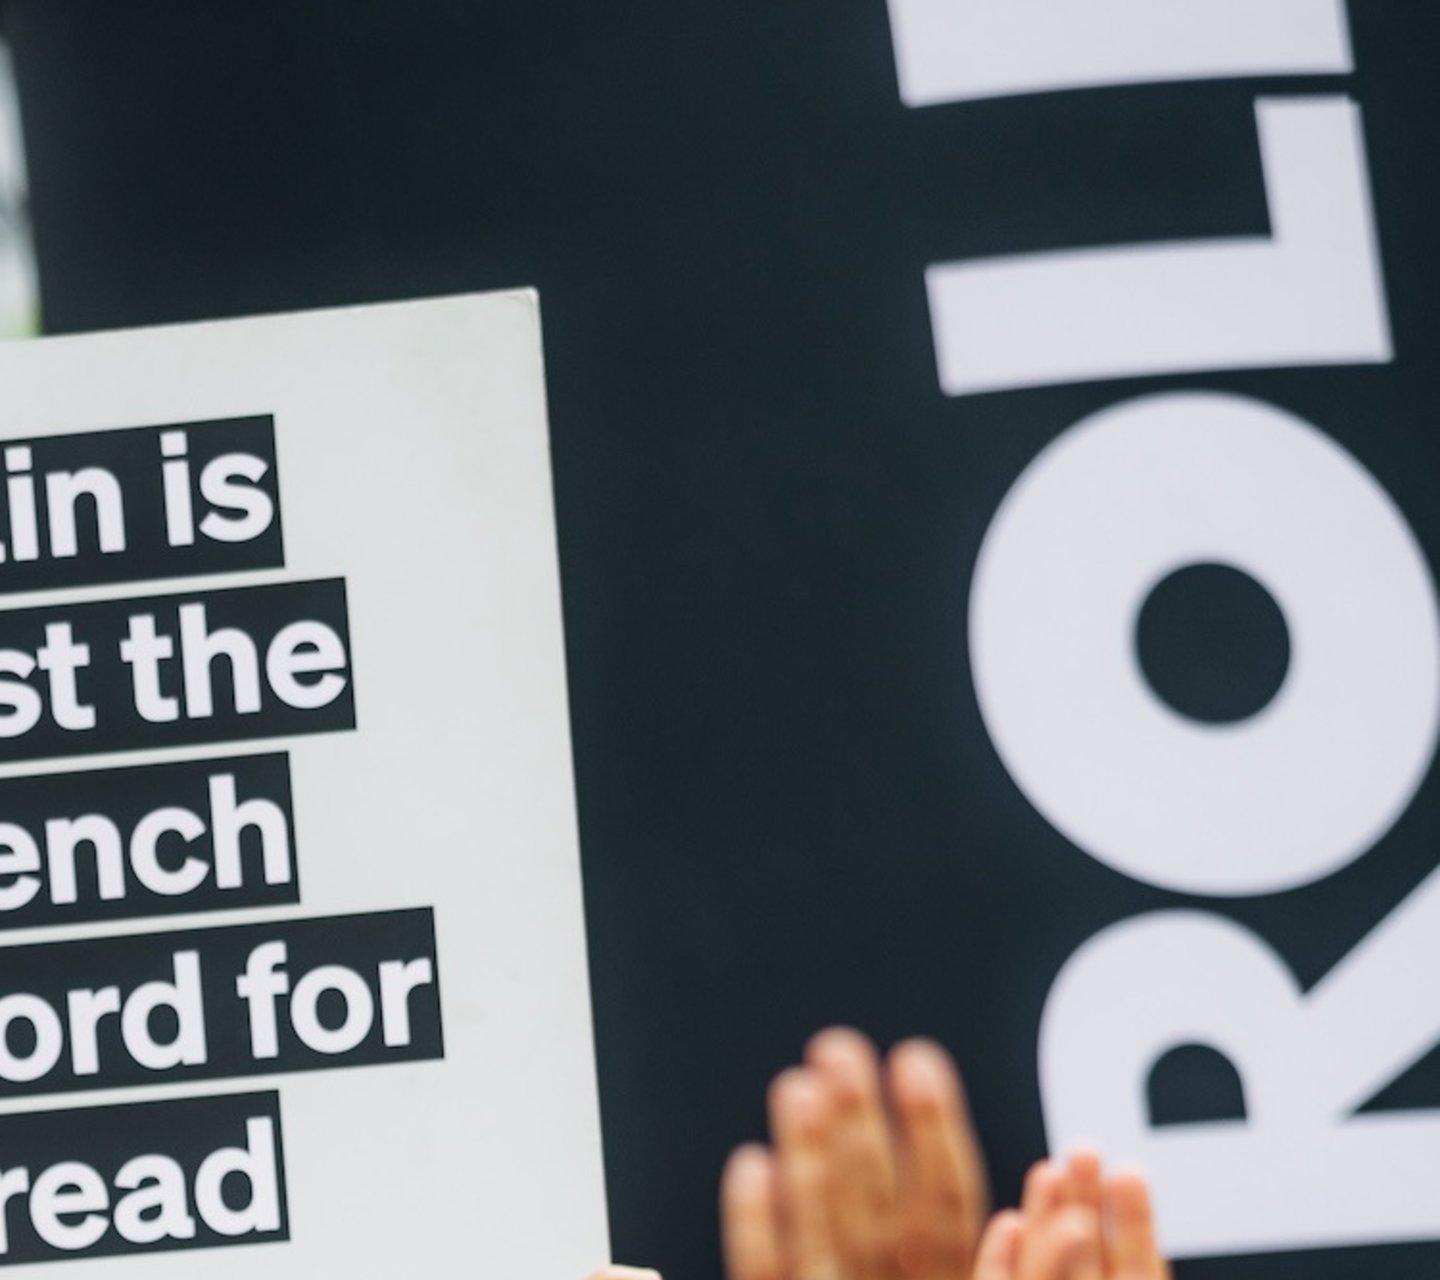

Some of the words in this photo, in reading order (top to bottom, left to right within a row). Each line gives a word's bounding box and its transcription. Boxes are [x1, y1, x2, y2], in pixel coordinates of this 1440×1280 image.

[160, 434, 275, 547] is
[122, 603, 348, 723] the
[236, 941, 433, 1059] for
